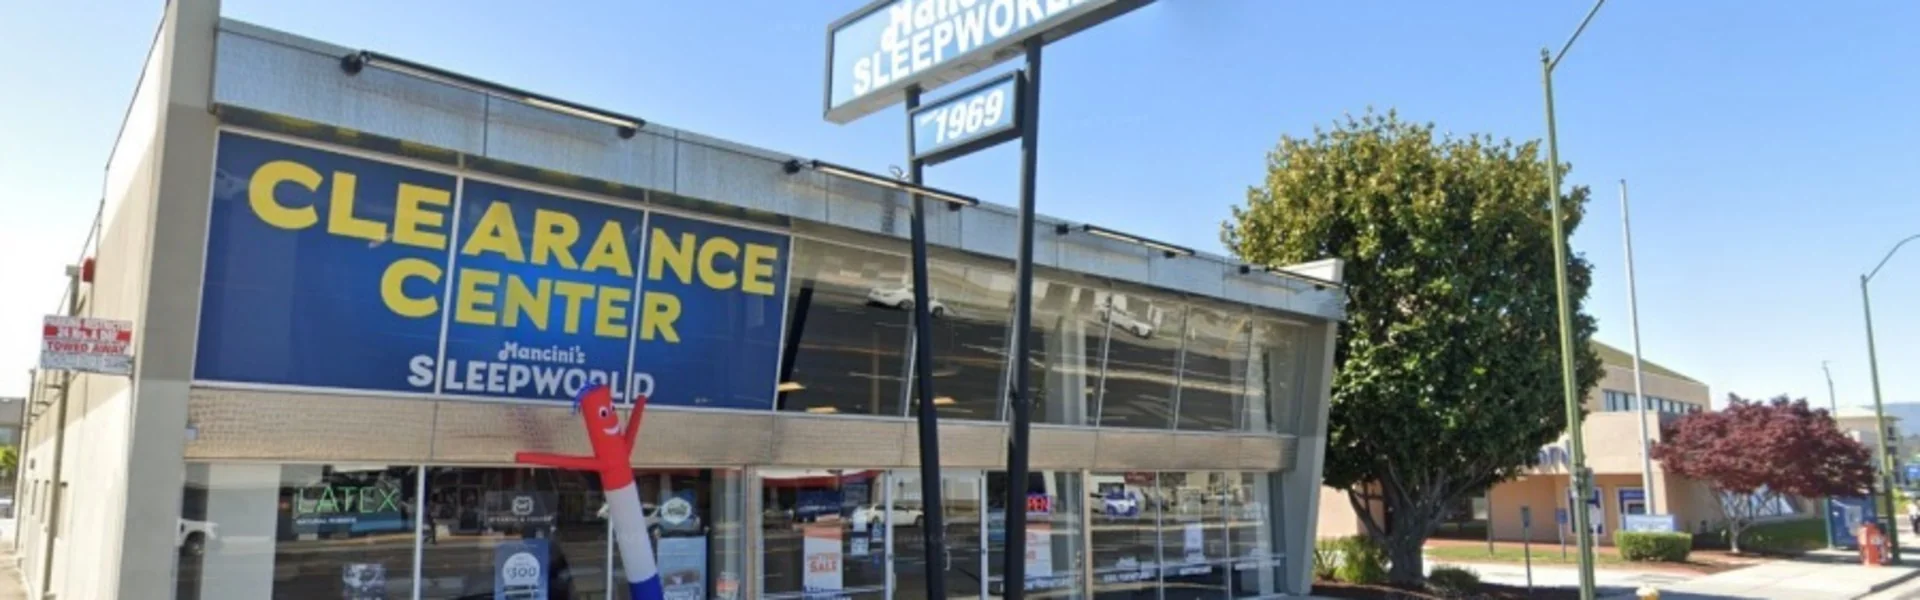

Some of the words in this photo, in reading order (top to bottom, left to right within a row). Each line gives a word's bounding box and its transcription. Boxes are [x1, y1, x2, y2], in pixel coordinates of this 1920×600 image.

[852, 0, 1094, 97] SLEEPWOR
[935, 88, 1004, 144] 1969
[247, 160, 778, 296] CLEARANCE
[380, 258, 682, 343] CENTER
[47, 340, 88, 353] TOWED
[91, 342, 126, 355] AWAY
[498, 341, 586, 364] Mancini's
[298, 486, 400, 513] LATEX
[1026, 496, 1051, 511] PEN
[810, 560, 837, 573] SALE
